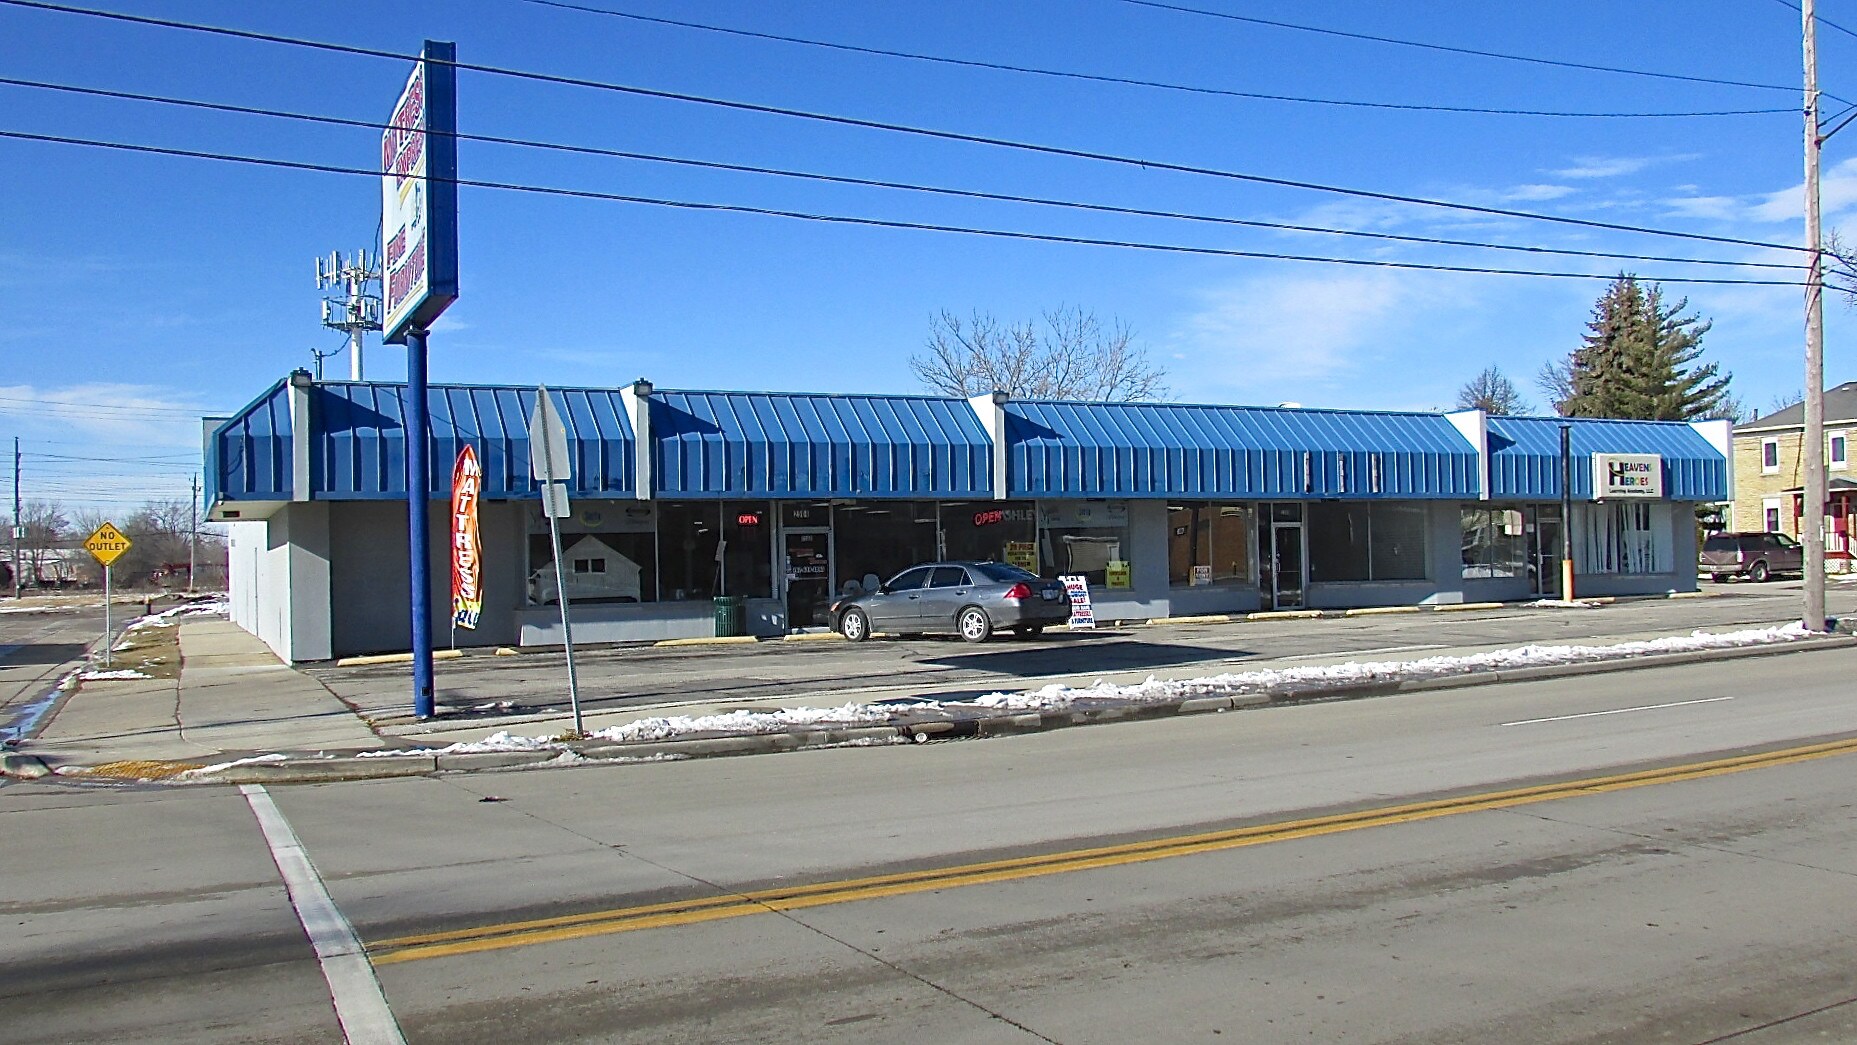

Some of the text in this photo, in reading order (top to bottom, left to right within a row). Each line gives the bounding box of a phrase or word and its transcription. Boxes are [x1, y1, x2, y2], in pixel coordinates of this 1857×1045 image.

[738, 514, 759, 525] OPEN
[974, 508, 1002, 526] OPEN
[455, 458, 481, 600] MATTRESS
[100, 531, 115, 540] NO
[89, 542, 126, 551] OUTLET
